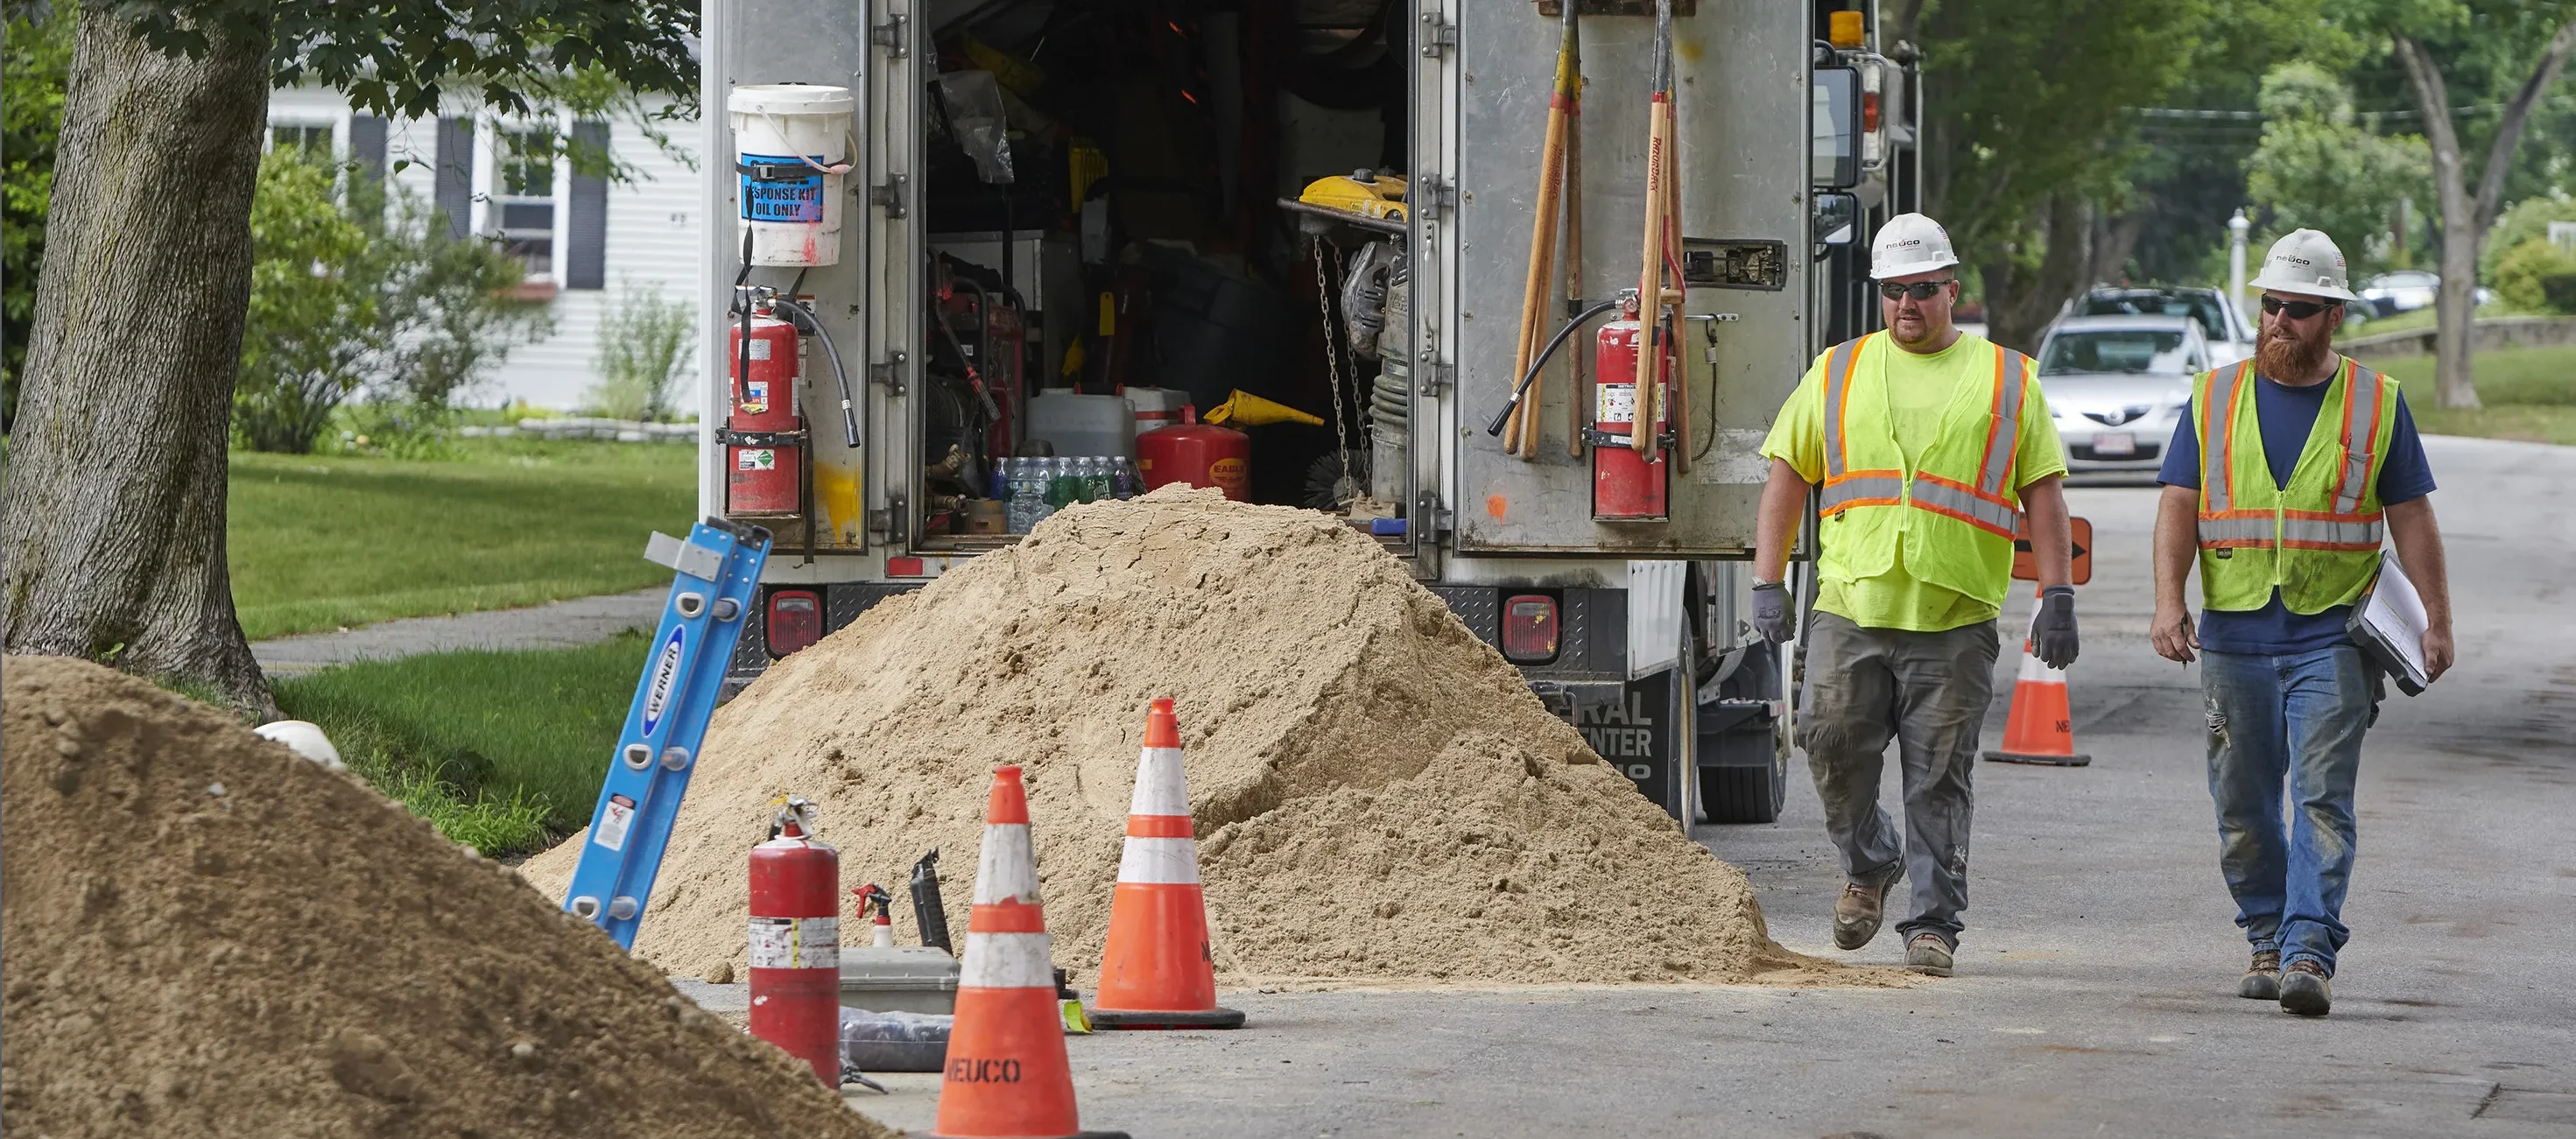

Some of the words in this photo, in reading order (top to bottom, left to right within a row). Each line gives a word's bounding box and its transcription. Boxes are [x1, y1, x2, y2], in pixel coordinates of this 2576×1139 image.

[799, 186, 817, 200] KIT
[756, 203, 771, 215] OIL
[774, 203, 800, 216] ONLY
[2277, 255, 2310, 265] neuco
[650, 648, 677, 713] WERNER
[947, 1058, 1021, 1084] NEUCO
